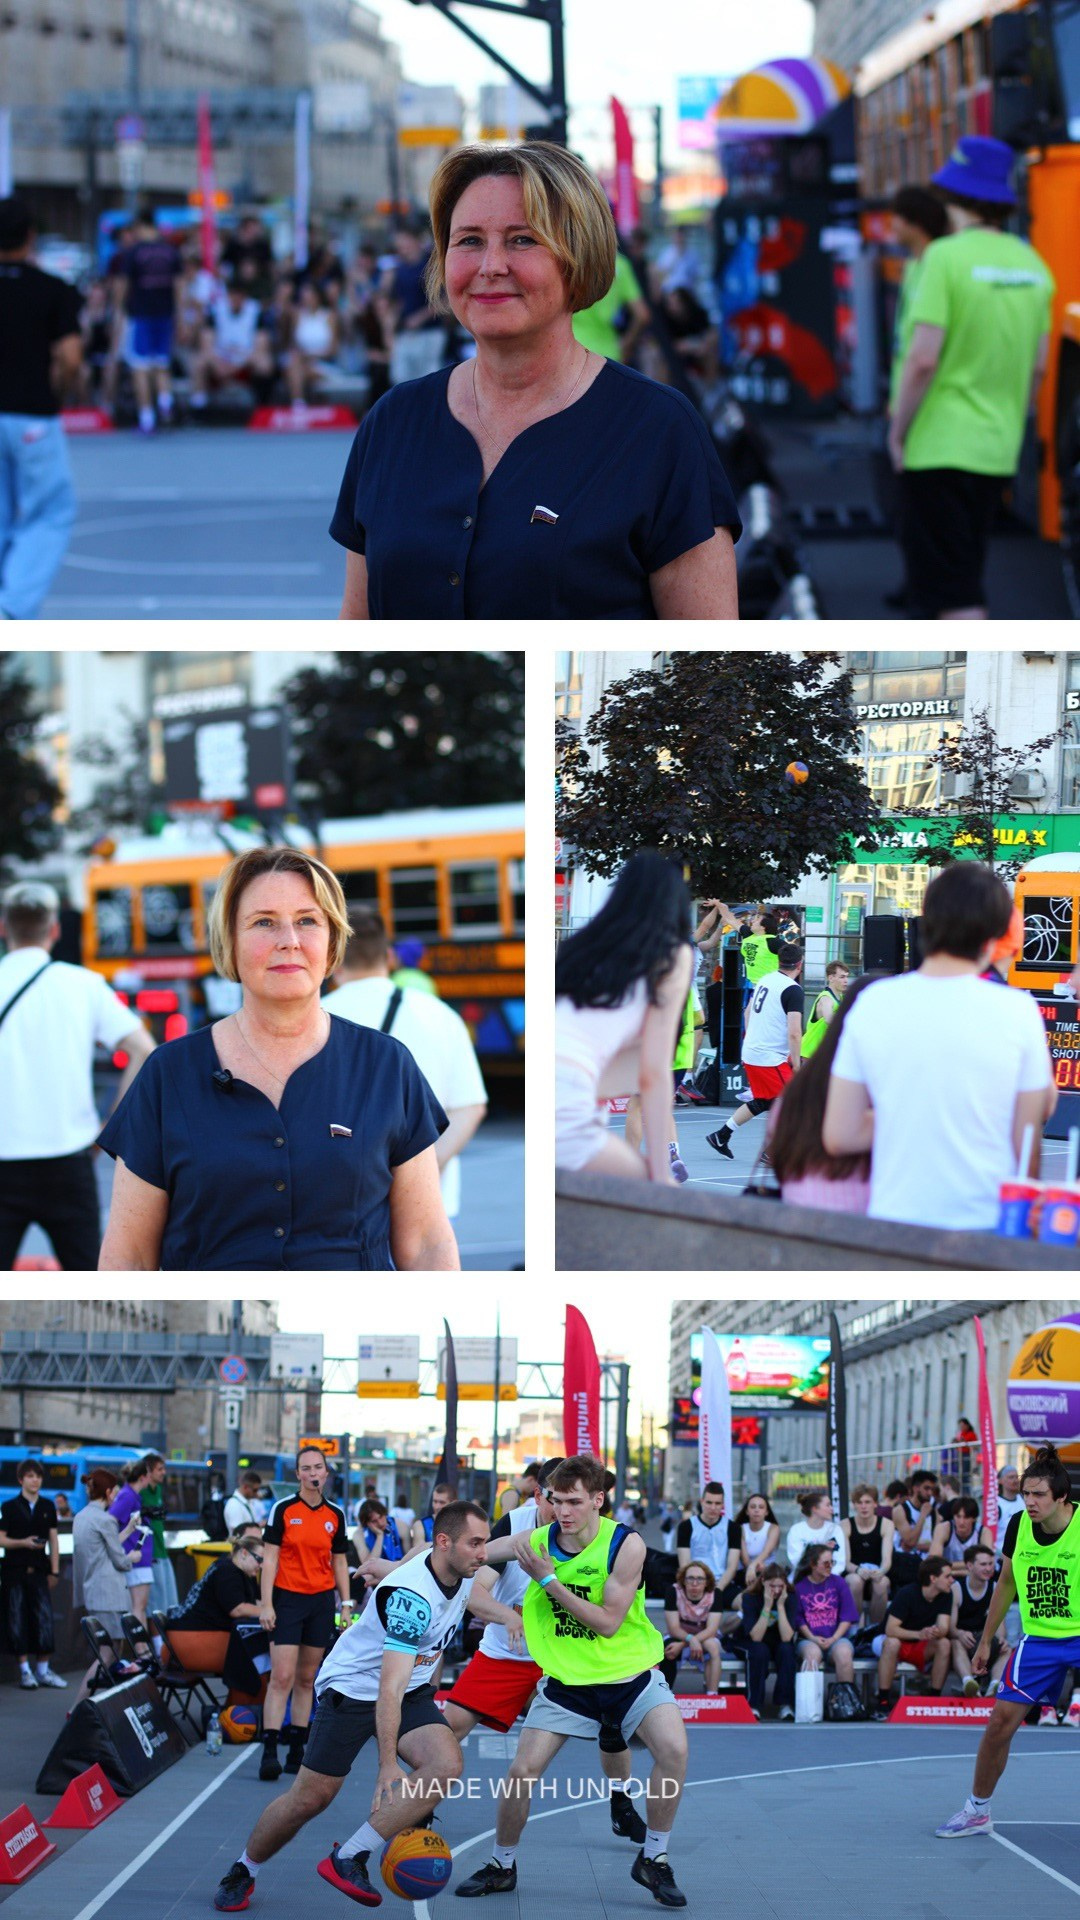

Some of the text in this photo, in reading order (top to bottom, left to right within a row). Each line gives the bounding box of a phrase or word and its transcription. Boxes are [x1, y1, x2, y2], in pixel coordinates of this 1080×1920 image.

[856, 699, 950, 719] РЕСТОРАН
[1055, 1021, 1079, 1032] TIME
[1026, 1583, 1071, 1598] БАСКЕТ
[1029, 1608, 1073, 1619] МОСКВА
[906, 1705, 993, 1717] STREETBASK
